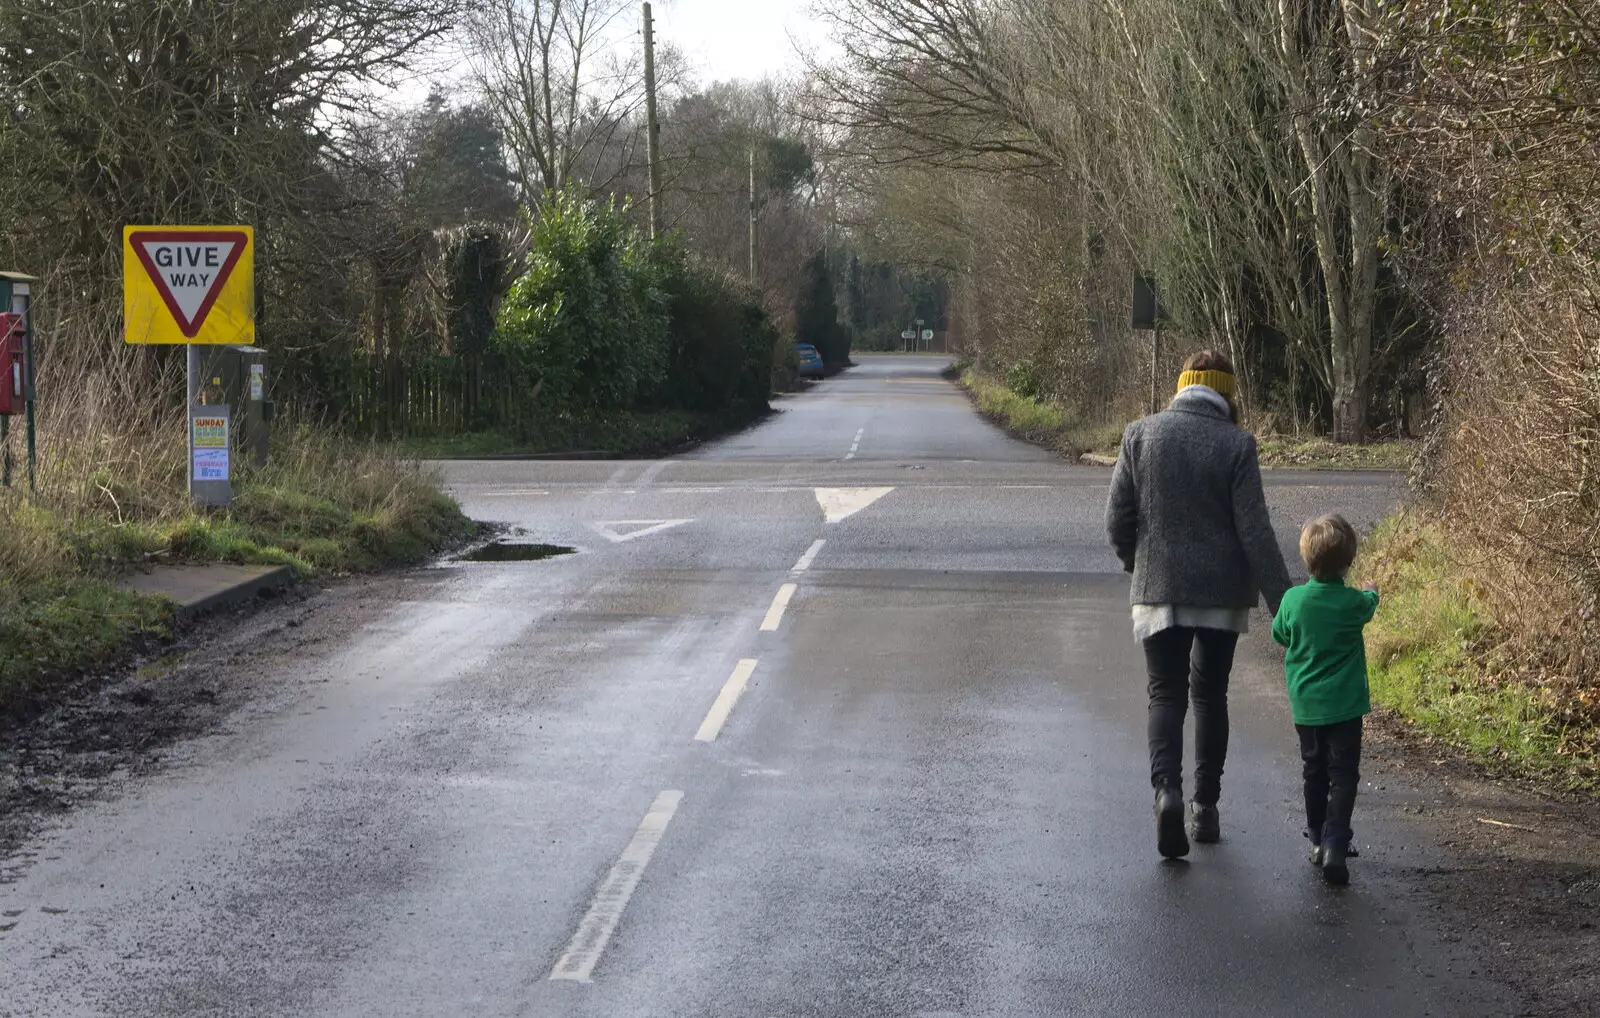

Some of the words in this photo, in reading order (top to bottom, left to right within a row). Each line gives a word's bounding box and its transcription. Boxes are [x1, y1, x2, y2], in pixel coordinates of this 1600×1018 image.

[155, 247, 218, 267] GIVE
[170, 273, 209, 287] WAY
[195, 419, 225, 427] SUNDAY
